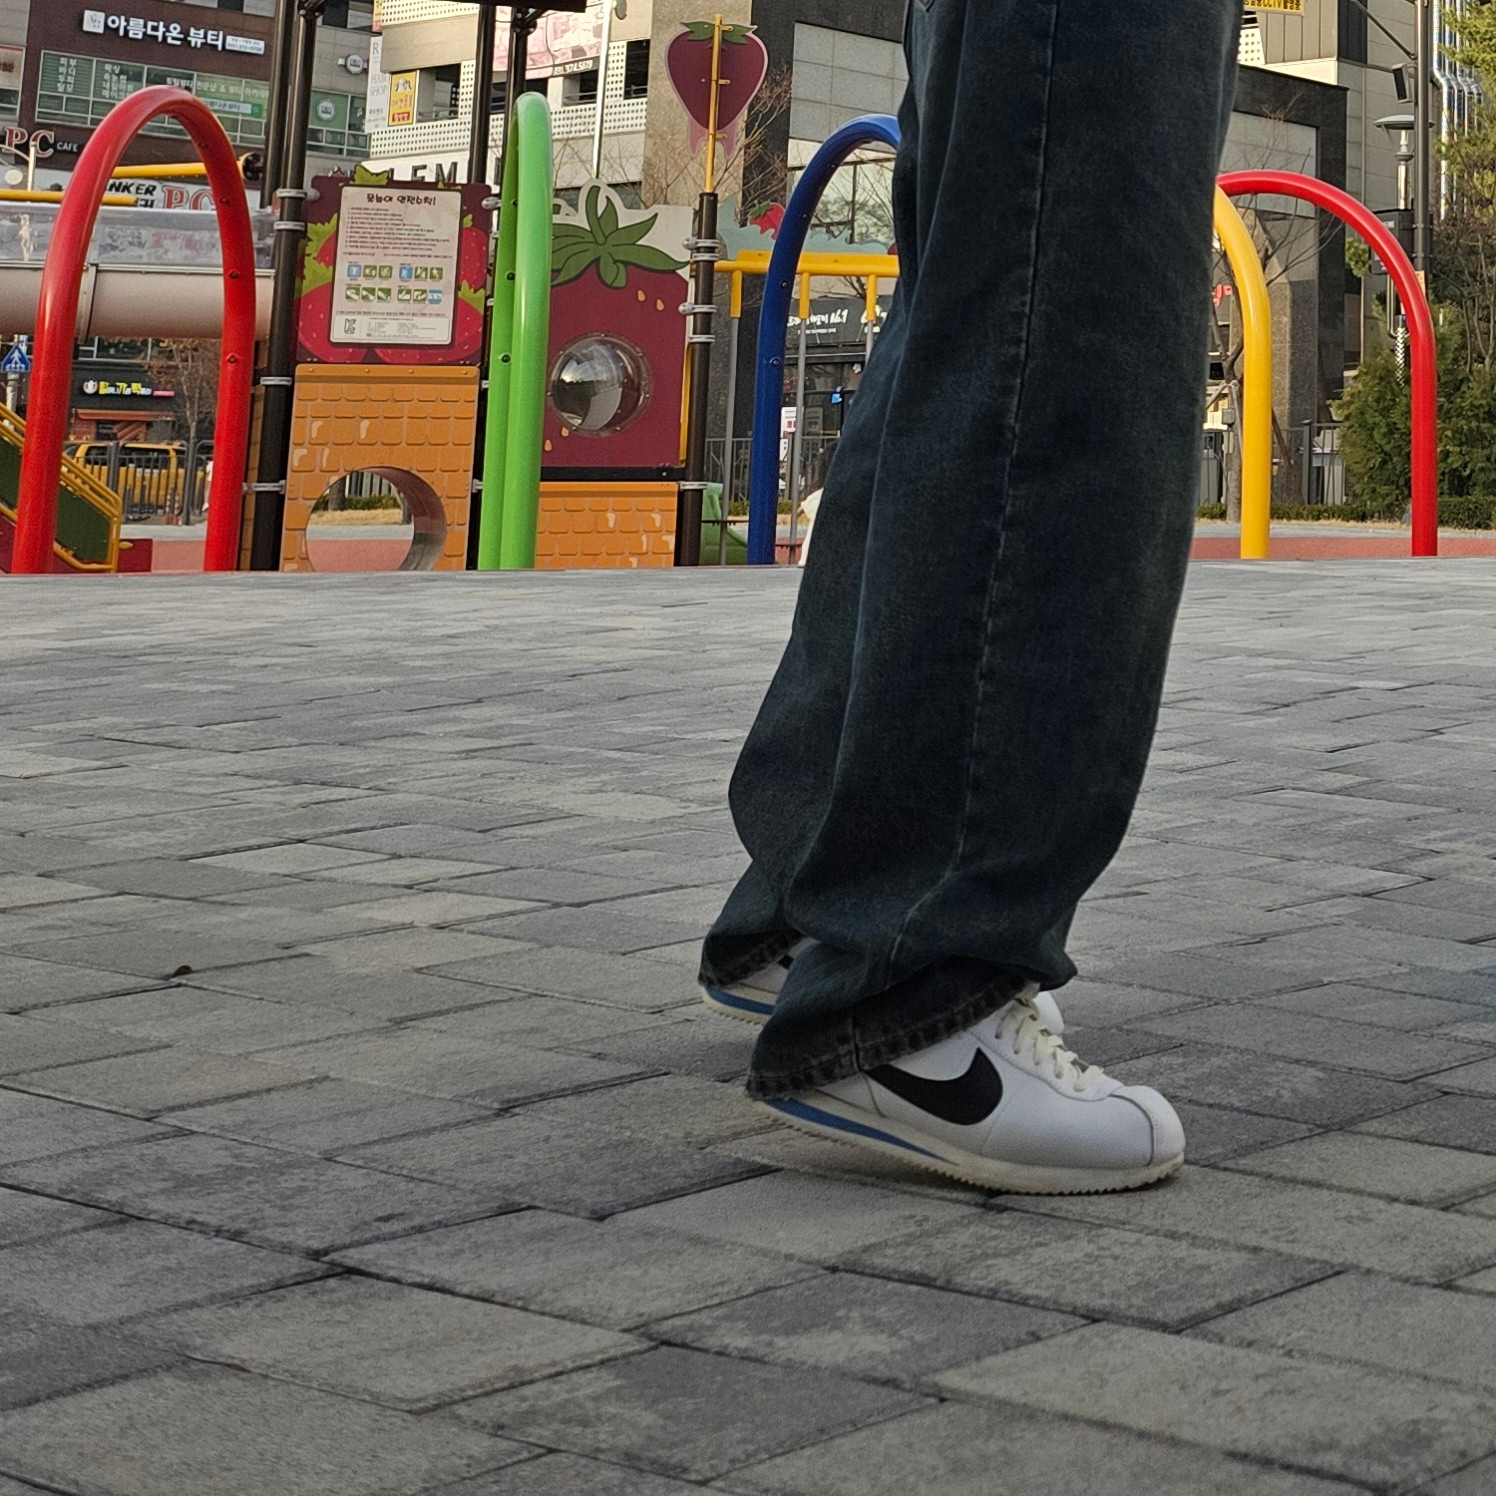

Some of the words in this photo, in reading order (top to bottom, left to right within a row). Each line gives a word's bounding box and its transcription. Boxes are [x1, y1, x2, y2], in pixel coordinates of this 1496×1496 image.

[107, 15, 184, 46] 아름다온
[187, 26, 224, 52] 뷰티
[2, 126, 54, 158] PC
[56, 141, 79, 153] CAFE
[105, 180, 157, 197] NKER
